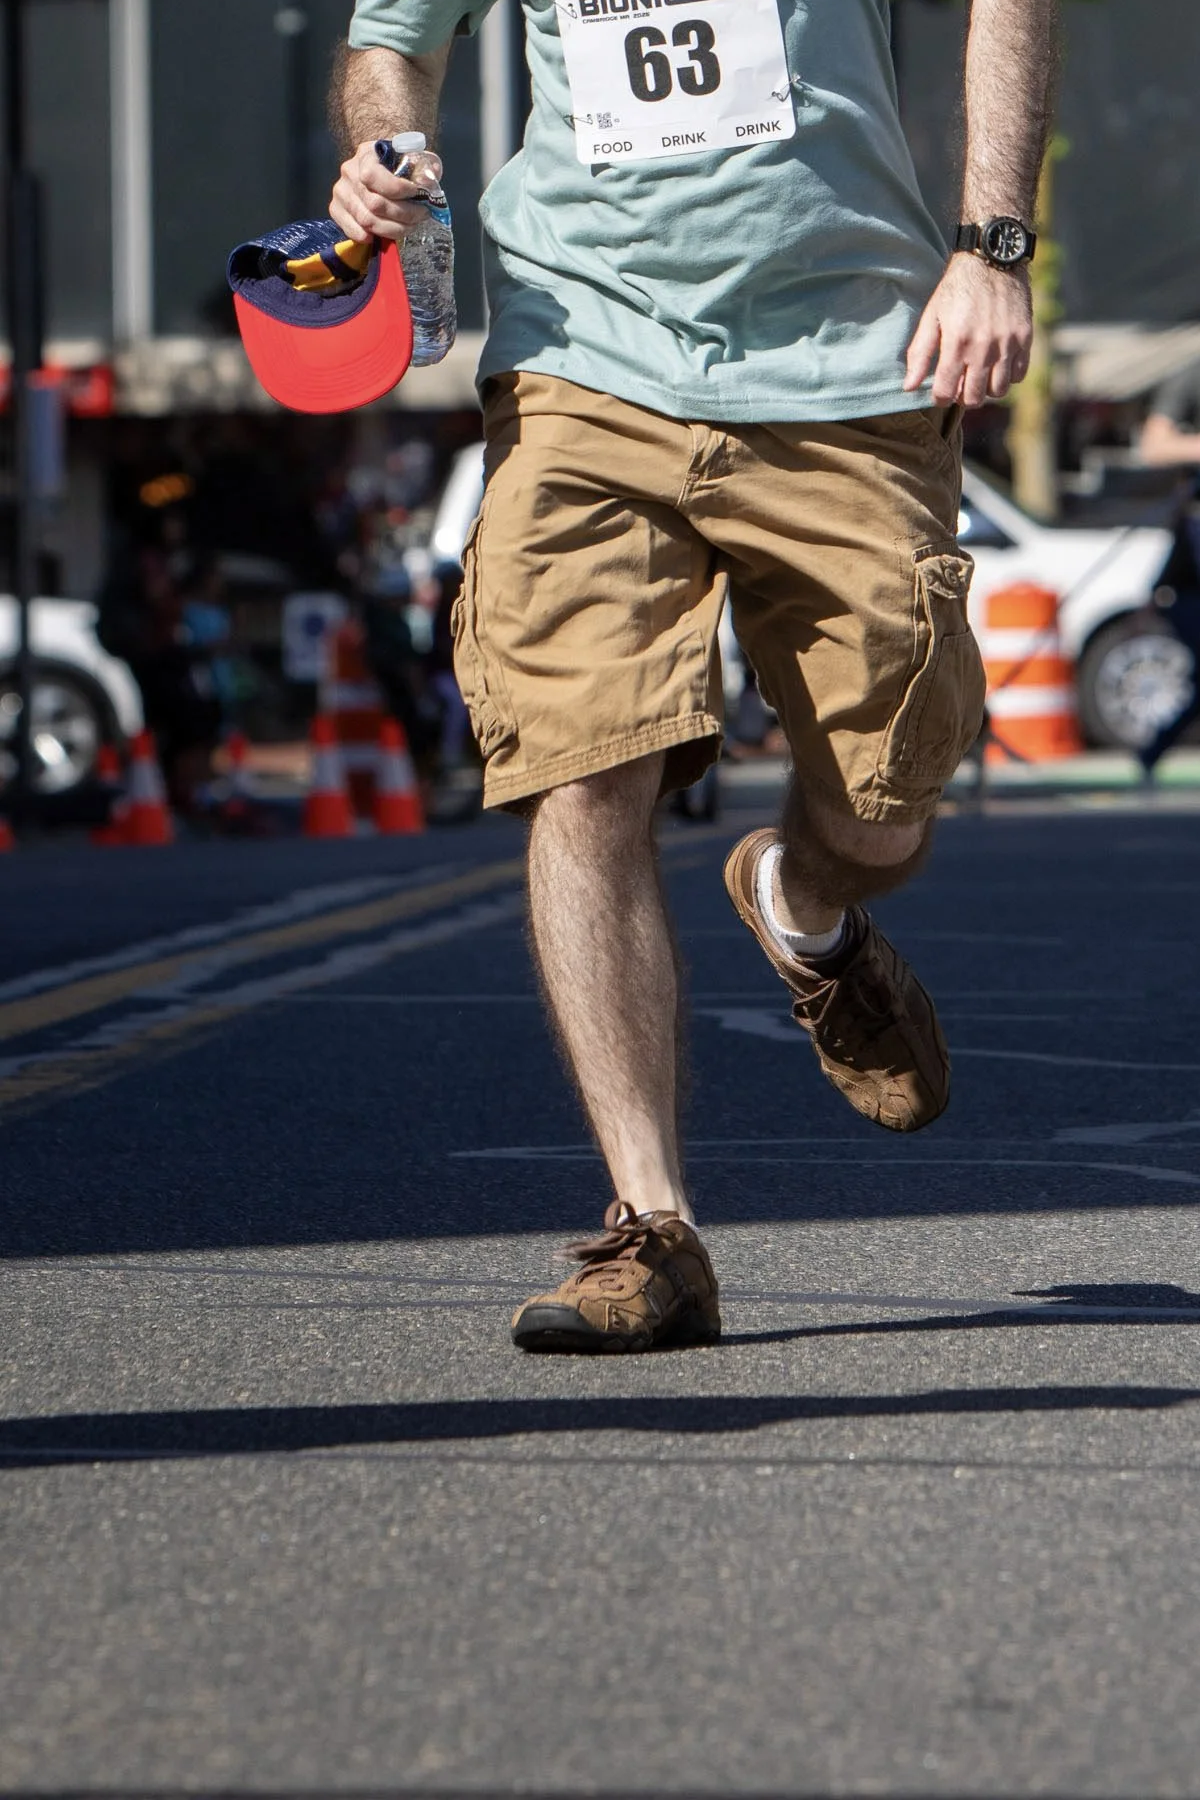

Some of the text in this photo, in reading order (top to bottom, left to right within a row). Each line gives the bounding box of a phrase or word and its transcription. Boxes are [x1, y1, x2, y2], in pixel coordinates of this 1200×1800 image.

[624, 19, 721, 103] 63
[593, 120, 782, 156] FOOD DRINK DRINK
